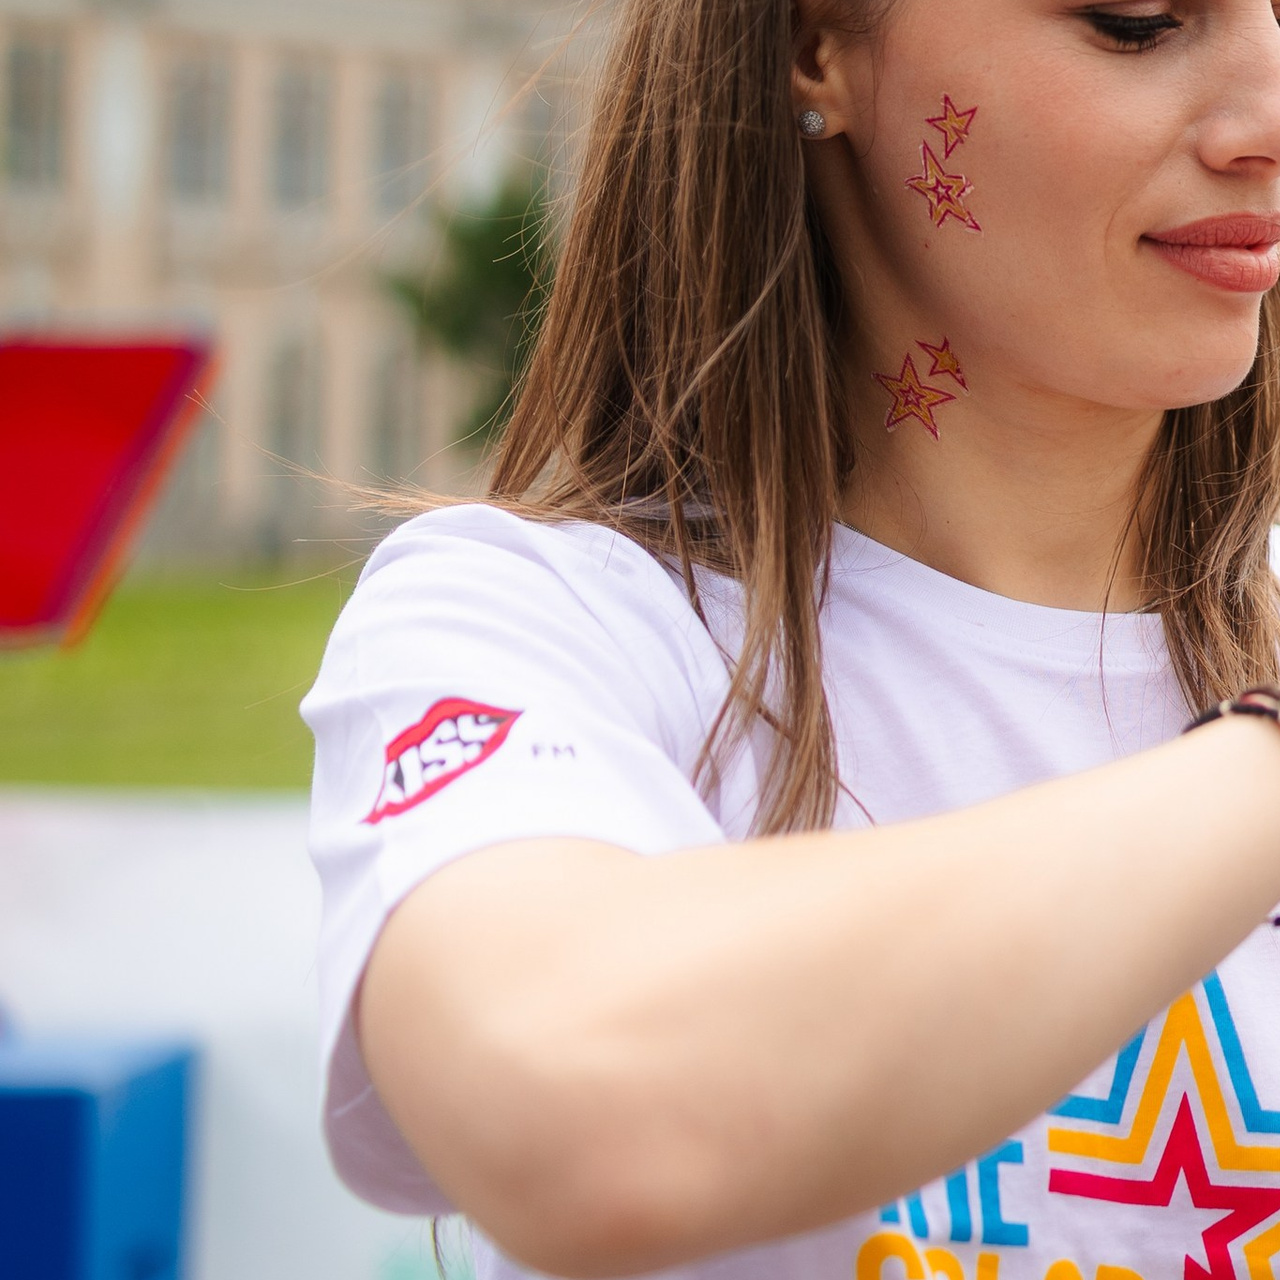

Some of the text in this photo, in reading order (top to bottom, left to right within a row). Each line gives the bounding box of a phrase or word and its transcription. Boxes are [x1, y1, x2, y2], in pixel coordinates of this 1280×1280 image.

[373, 713, 577, 810] KISS FM
[880, 1140, 1029, 1246] HE
